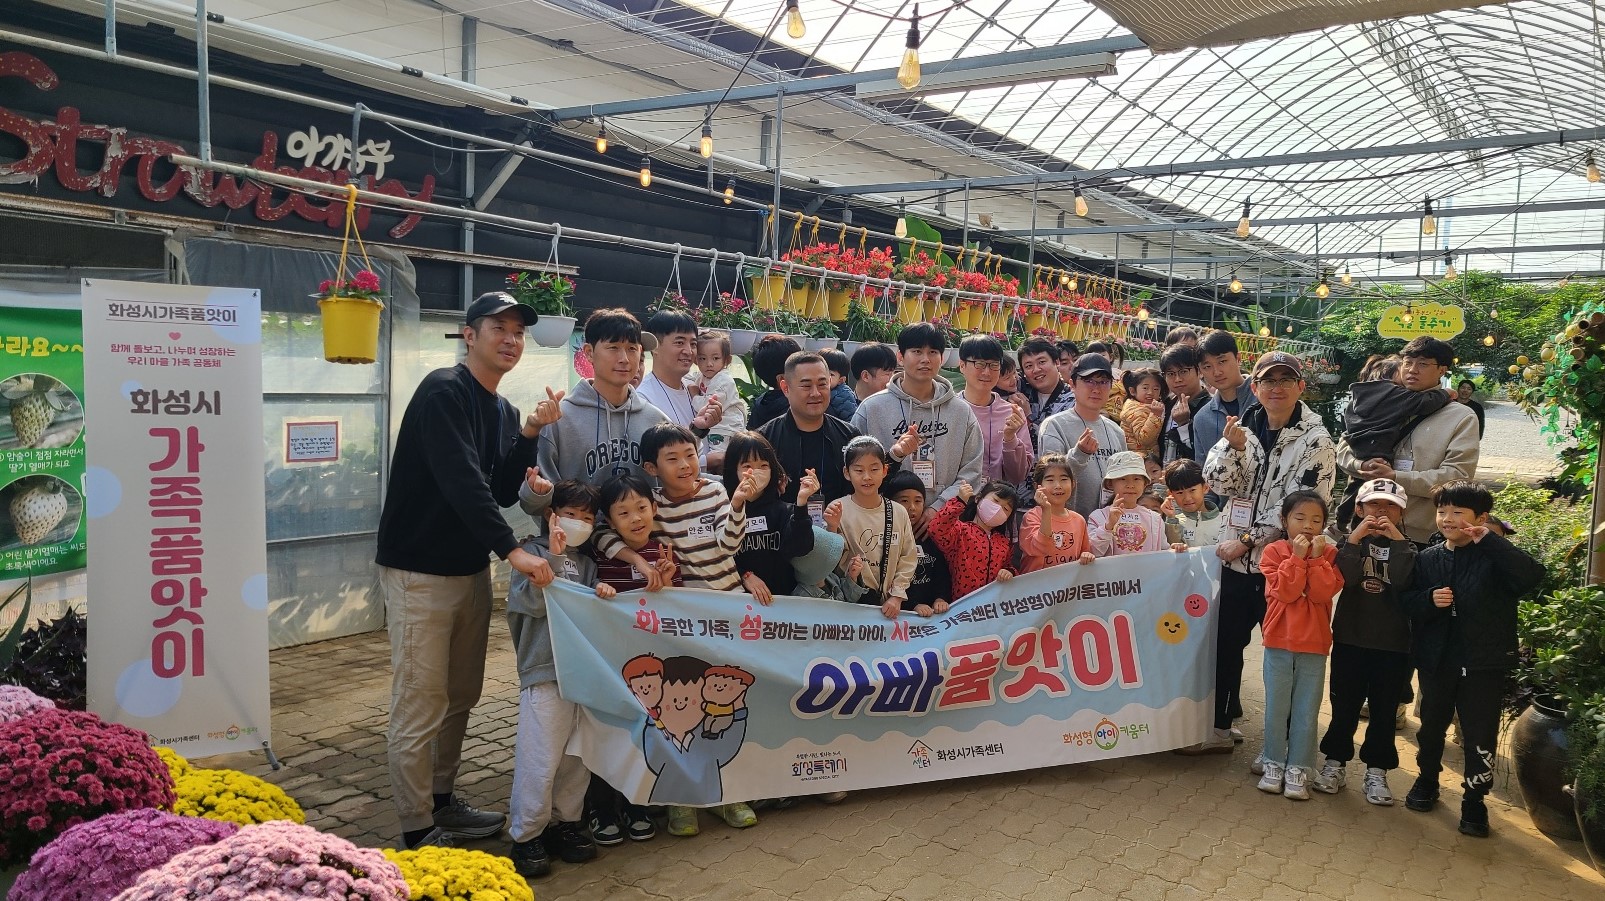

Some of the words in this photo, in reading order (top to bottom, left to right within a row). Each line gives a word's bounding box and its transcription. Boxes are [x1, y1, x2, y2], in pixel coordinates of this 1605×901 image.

[108, 303, 237, 322] 화성시가족품앗이
[0, 336, 84, 357] 라요~~
[110, 344, 131, 353] 함께
[168, 346, 196, 355] 나누며
[199, 347, 237, 357] 성장하는
[127, 356, 147, 366] 우리
[149, 357, 169, 367] 마을
[173, 358, 191, 367] 가족
[193, 359, 222, 368] 공동체
[130, 389, 221, 415] 화성시
[892, 420, 948, 440] Aletics
[36, 450, 52, 461] 점점
[54, 447, 84, 458] 자라면서
[585, 437, 642, 477] OREGO
[8, 463, 27, 473] 딸기
[29, 461, 53, 472] 열매가
[1374, 480, 1398, 494] 21
[148, 425, 208, 679] 가족품앗이
[633, 606, 695, 637] 화목한
[697, 619, 734, 640] 가족,
[740, 611, 808, 641] 성장하는
[812, 623, 856, 642] 아빠와
[858, 624, 887, 643] 아이,
[890, 619, 940, 642] 시작은
[939, 602, 999, 631] 가족센터
[1000, 578, 1142, 618] 화성형아이키움터에서
[794, 611, 1140, 718] 아빠품앗이
[1062, 730, 1093, 747] 화성형
[1096, 727, 1117, 740] 아이
[1119, 722, 1150, 740] 키움터
[936, 742, 1005, 762] 화성시가족센터
